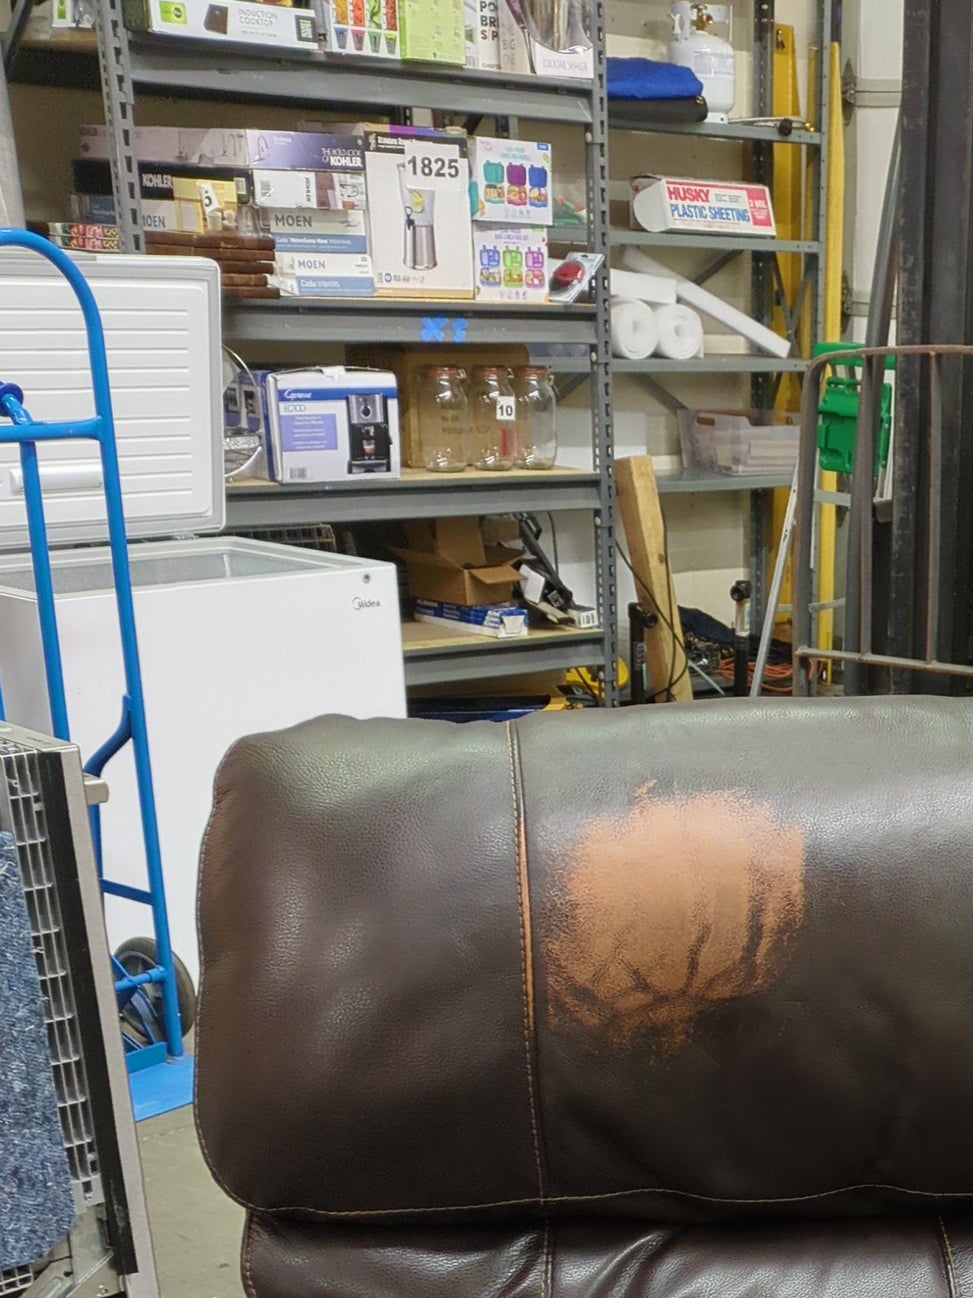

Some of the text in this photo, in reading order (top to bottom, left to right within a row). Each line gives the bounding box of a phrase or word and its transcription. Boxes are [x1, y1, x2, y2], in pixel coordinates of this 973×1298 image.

[238, 8, 278, 20] INDUCTION
[239, 16, 274, 27] COOKTOP
[542, 58, 567, 69] COCKTAIL
[346, 148, 362, 156] LOOK
[330, 155, 364, 168] KOHLER
[407, 155, 459, 178] 1825
[141, 173, 173, 188] KOHLER
[667, 185, 711, 203] HUSKY
[669, 203, 708, 220] PLASTIC
[708, 206, 750, 223] SHEETING
[274, 214, 313, 228] MOEN
[298, 260, 326, 269] MOEN
[498, 405, 513, 417] 10
[352, 596, 381, 611] Midea
